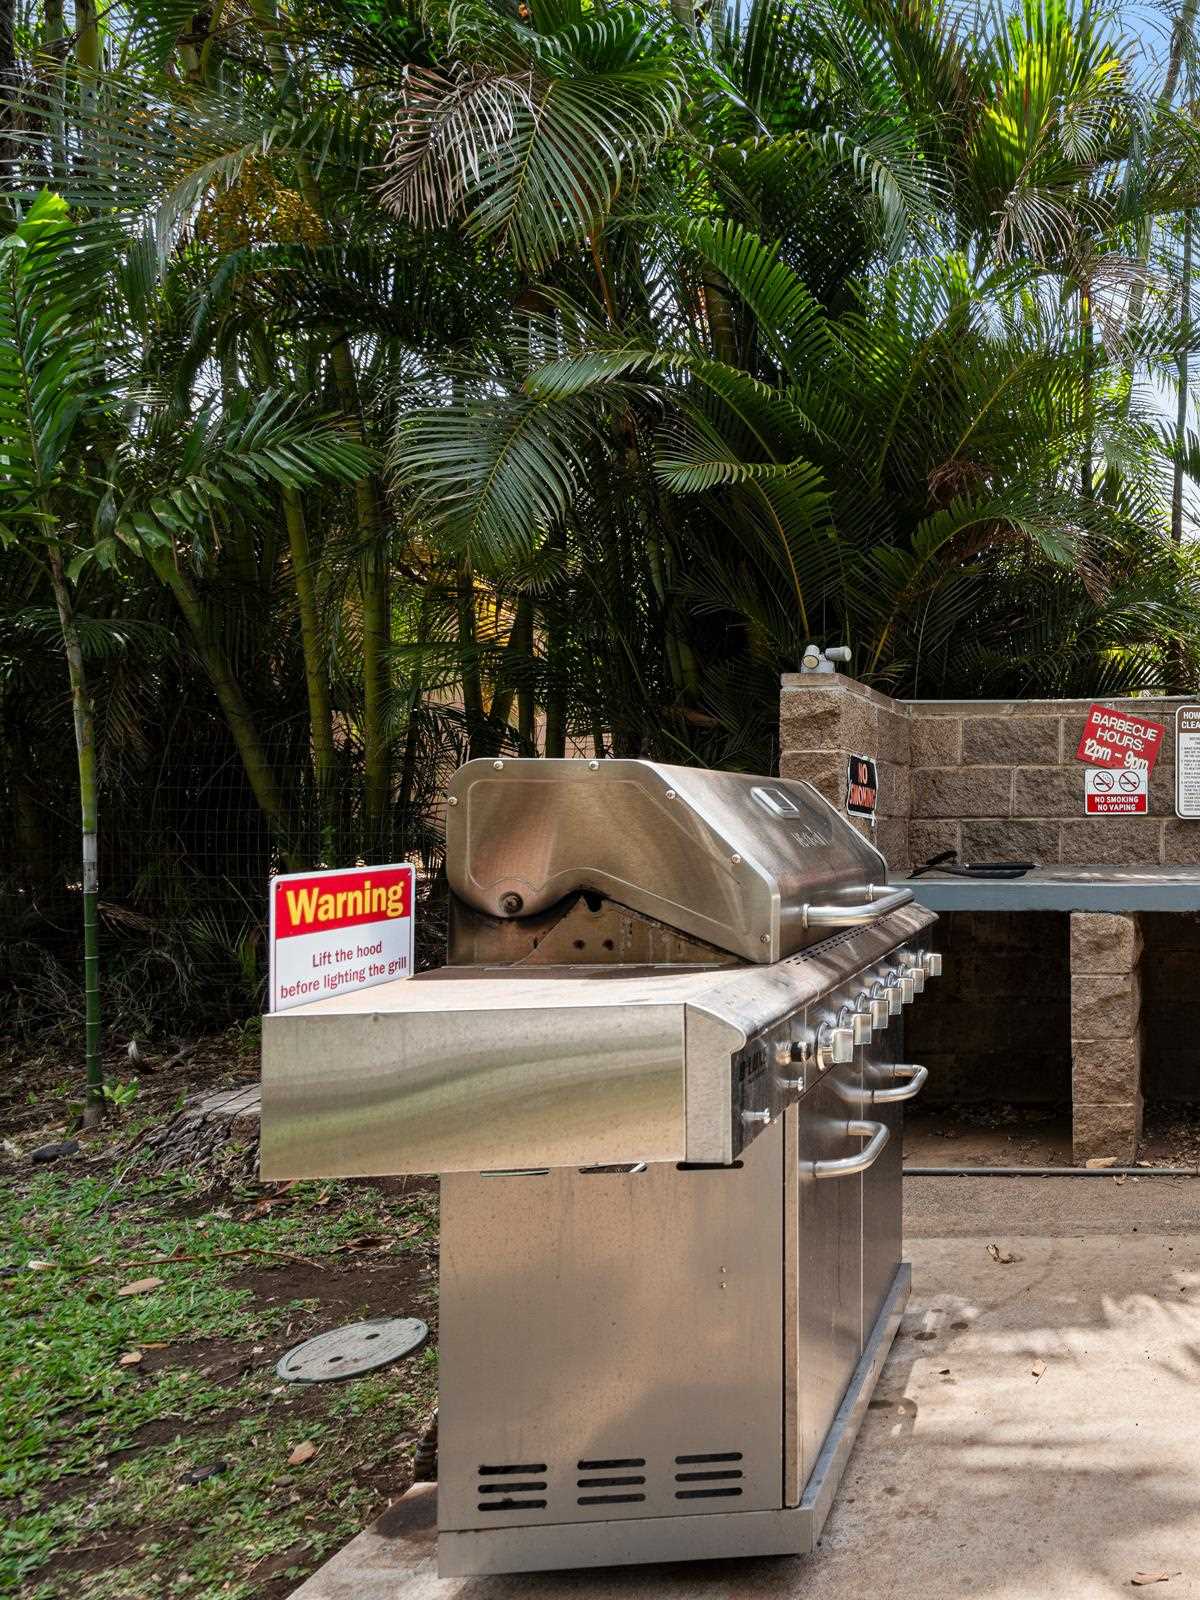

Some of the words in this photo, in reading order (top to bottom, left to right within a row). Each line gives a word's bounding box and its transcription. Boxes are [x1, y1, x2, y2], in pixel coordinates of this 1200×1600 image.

[1091, 711, 1159, 741] BARBECUE
[1183, 711, 1200, 720] HOW
[1083, 738, 1112, 761] 12pm
[1123, 750, 1149, 770] 9pm
[1095, 727, 1145, 752] HOURS:
[286, 879, 405, 926] Warning
[312, 951, 333, 968] Lift
[335, 948, 353, 963] the
[356, 941, 383, 958] hood
[280, 979, 321, 999] before
[323, 966, 367, 990] lighting
[368, 963, 386, 977] the
[388, 956, 408, 974] grill
